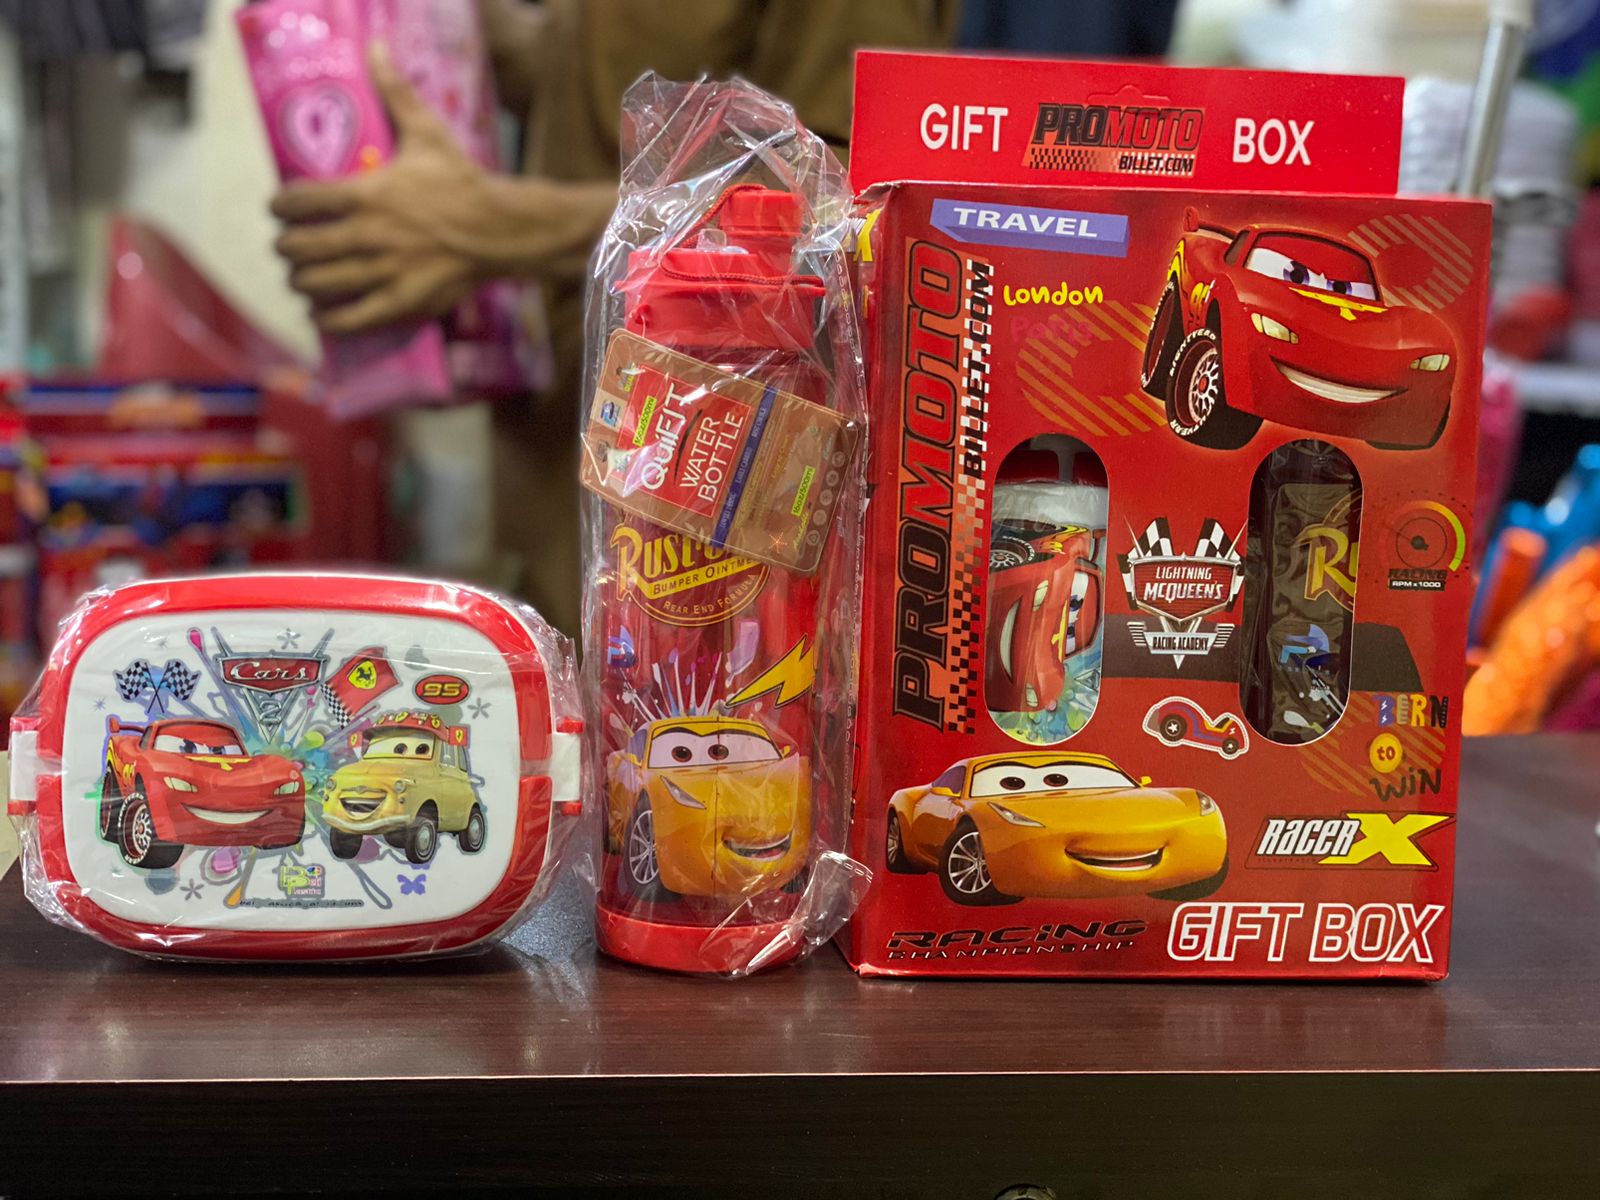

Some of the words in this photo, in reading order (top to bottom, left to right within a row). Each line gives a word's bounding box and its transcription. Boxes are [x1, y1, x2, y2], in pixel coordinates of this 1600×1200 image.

[920, 102, 1010, 154] GIFT
[1232, 116, 1314, 167] BOX
[1031, 103, 1204, 151] PROMOTO
[1118, 154, 1194, 173] BILLET.COM
[952, 205, 1098, 238] TRAVEL
[1003, 280, 1104, 307] London
[963, 258, 991, 480] BILLET.COM
[680, 416, 721, 487] WATER
[697, 411, 744, 502] BOTTLE
[893, 239, 963, 735] PROMOTO
[653, 573, 699, 595] BUMPER
[705, 556, 758, 578] OINTME
[1155, 565, 1212, 580] LIGHTNING
[1143, 580, 1224, 604] MCQUEEN'S
[663, 600, 689, 614] REAR
[693, 604, 715, 615] END
[1152, 636, 1177, 650] RACING
[1177, 637, 1209, 651] ACADEMY
[230, 661, 309, 681] Cars
[422, 683, 463, 698] 95
[257, 700, 282, 725] 2
[1376, 746, 1396, 761] to
[1316, 812, 1450, 866] X
[1166, 901, 1305, 963] GIFT
[1308, 902, 1446, 964] BOX
[887, 940, 1136, 960] CHAMPIONSHIP
